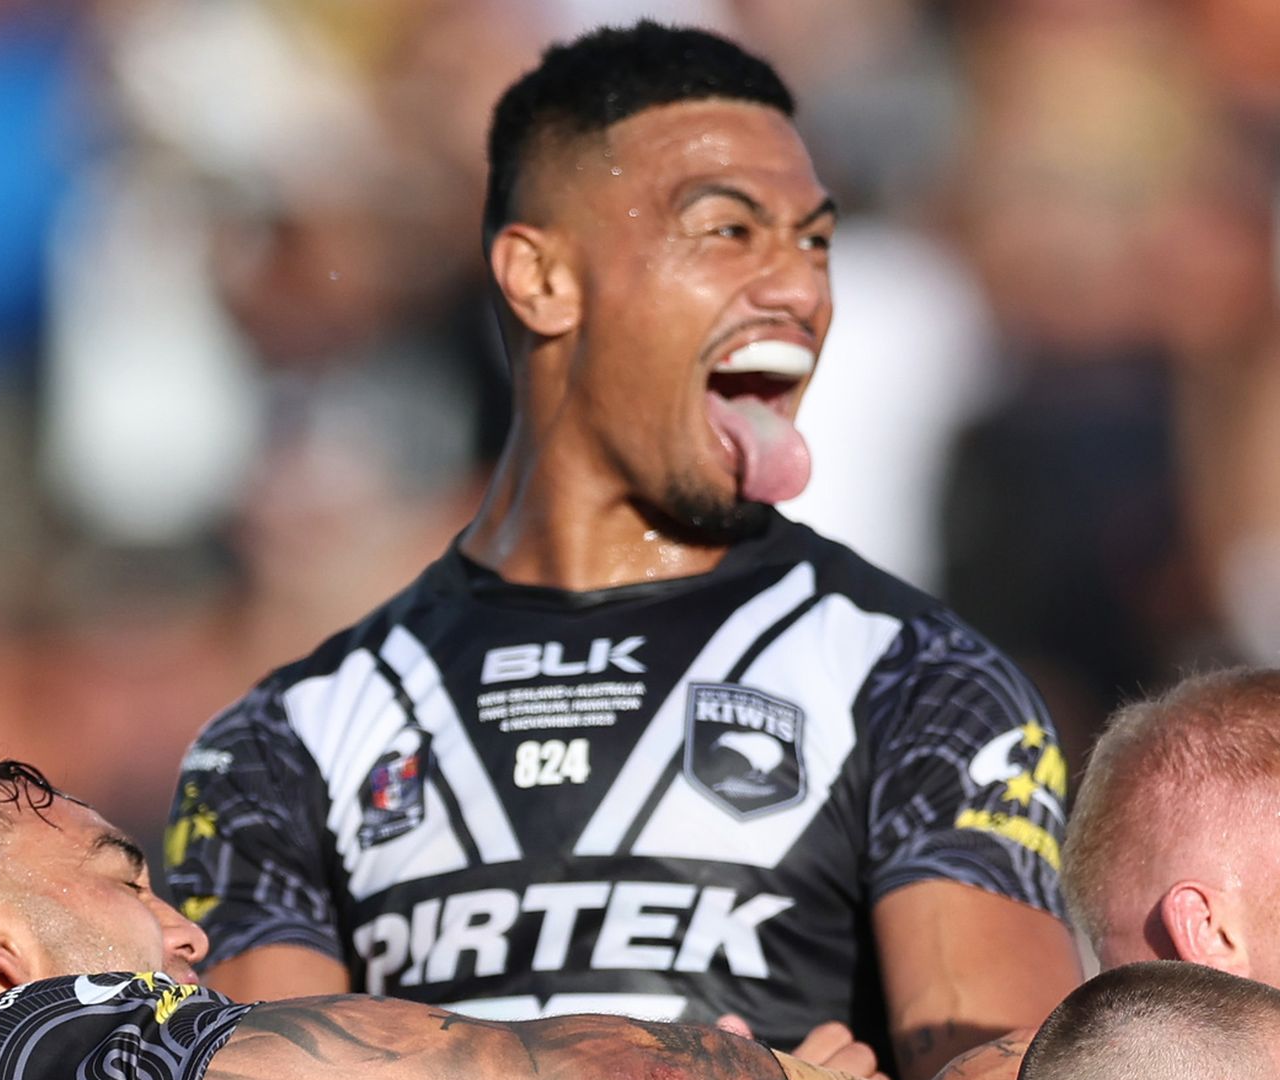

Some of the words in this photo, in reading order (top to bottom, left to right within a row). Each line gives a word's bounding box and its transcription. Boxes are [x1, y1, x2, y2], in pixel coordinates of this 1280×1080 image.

[480, 634, 647, 685] BLK
[696, 701, 794, 743] KIWIS
[513, 737, 591, 788] 824
[353, 880, 795, 998] PIRTEK
